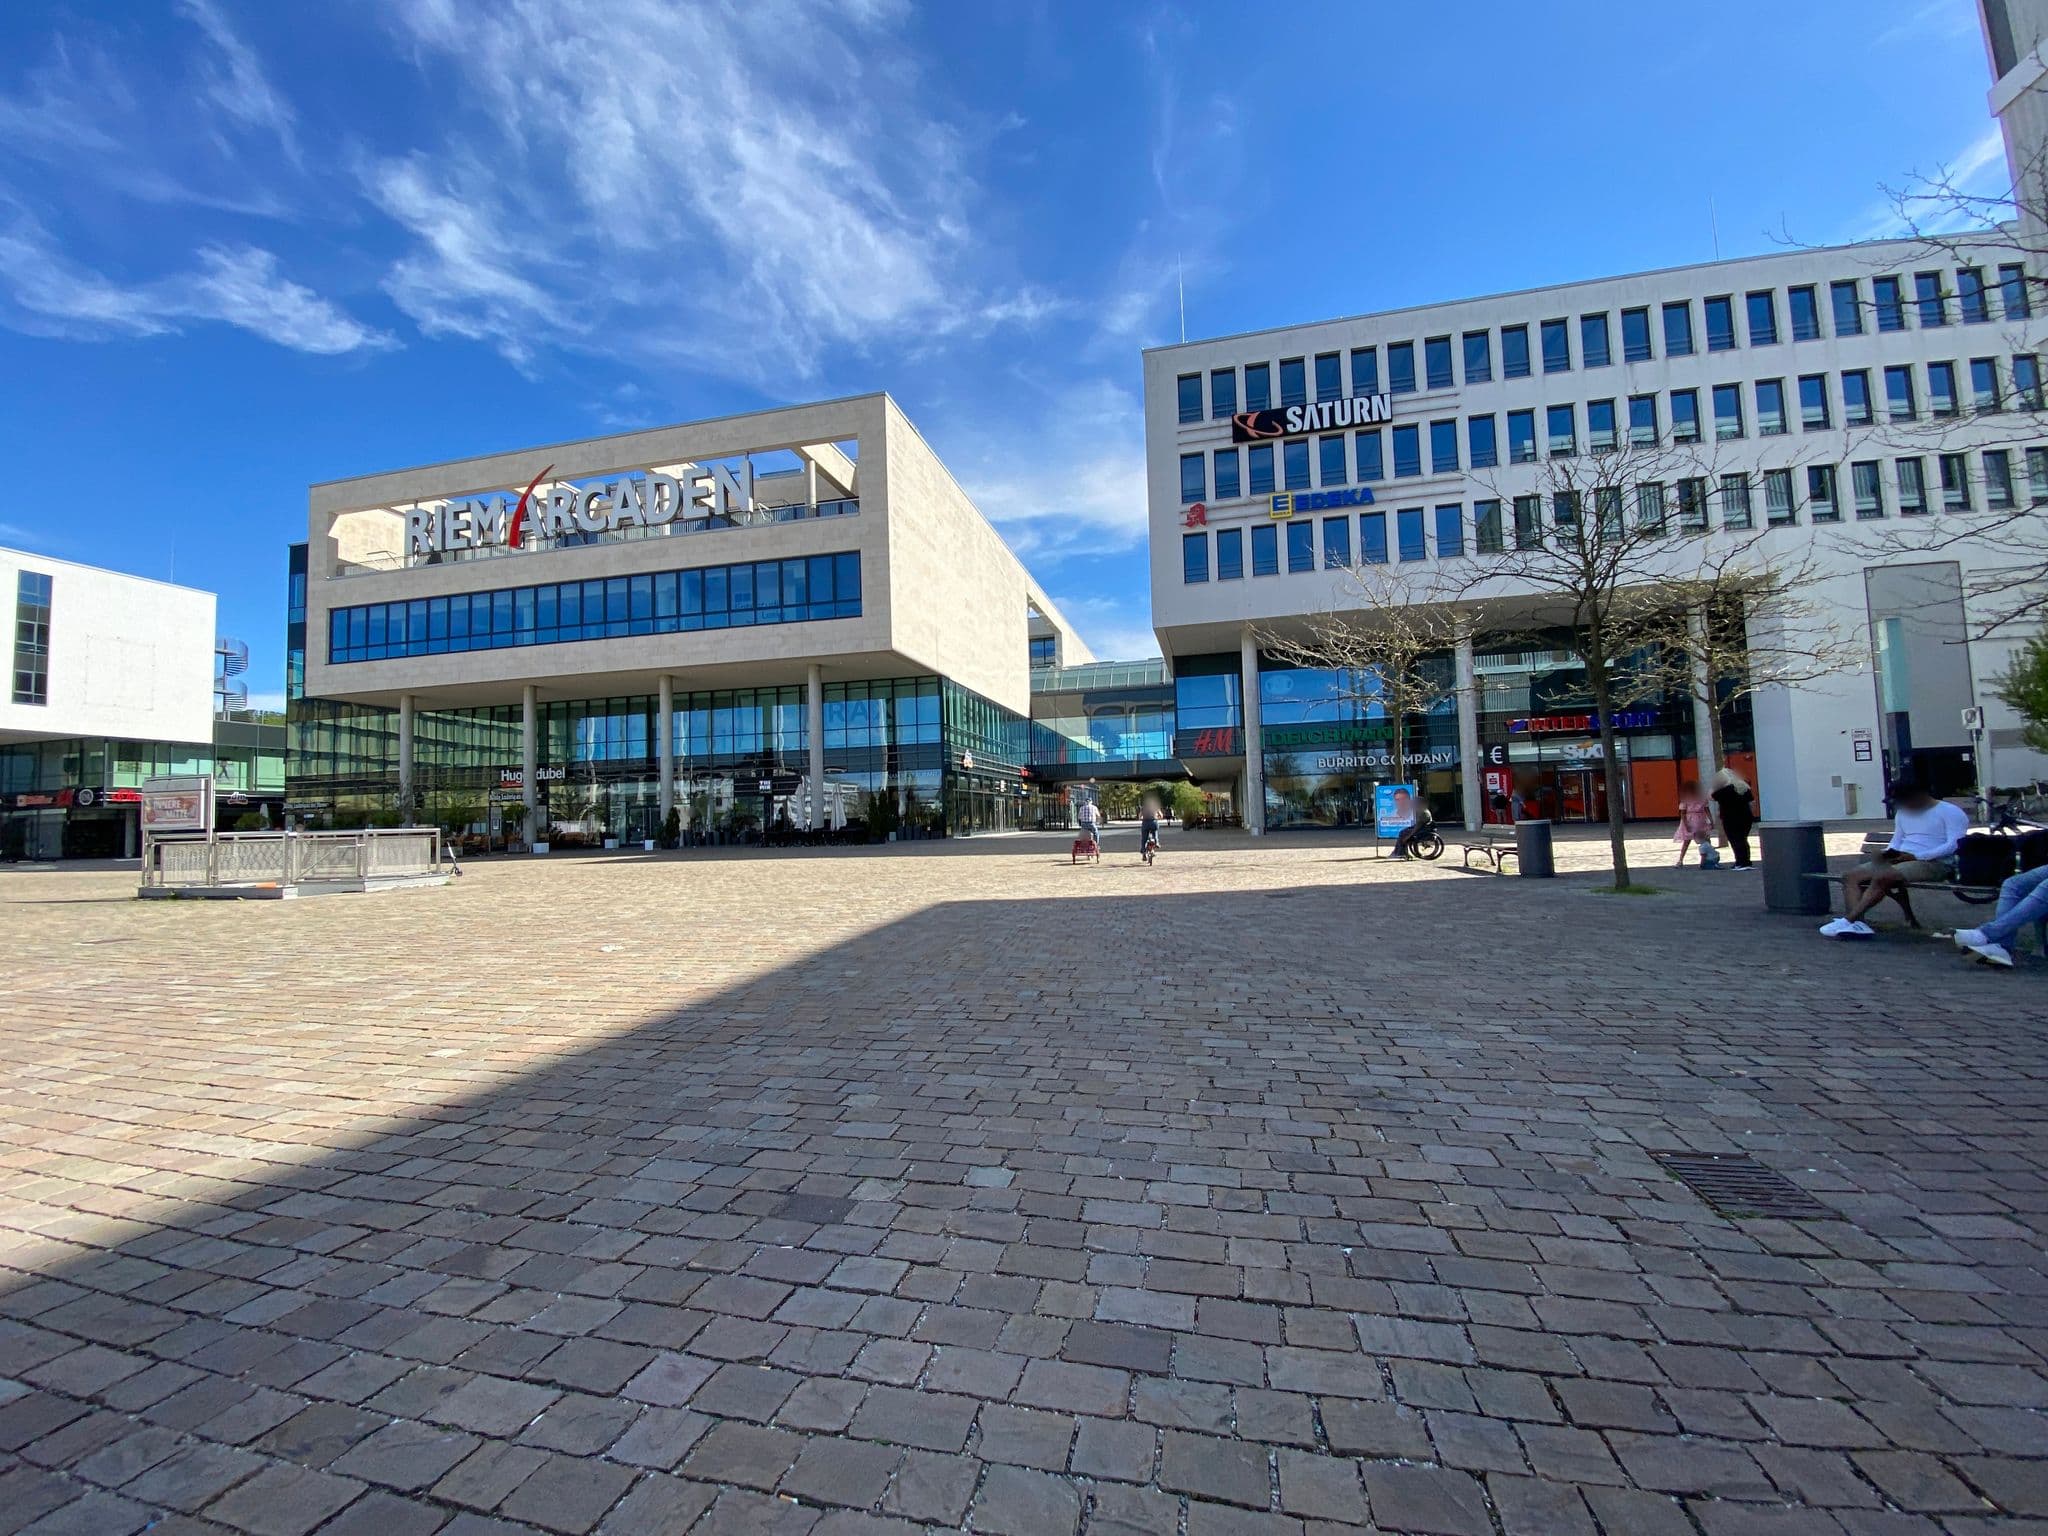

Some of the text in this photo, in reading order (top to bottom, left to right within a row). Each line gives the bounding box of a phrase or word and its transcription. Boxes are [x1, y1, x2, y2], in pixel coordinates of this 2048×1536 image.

[1286, 394, 1392, 433] SATURN
[1294, 487, 1375, 512] EDEKA
[1194, 726, 1233, 755] H&M
[1318, 756, 1376, 768] BURRITO
